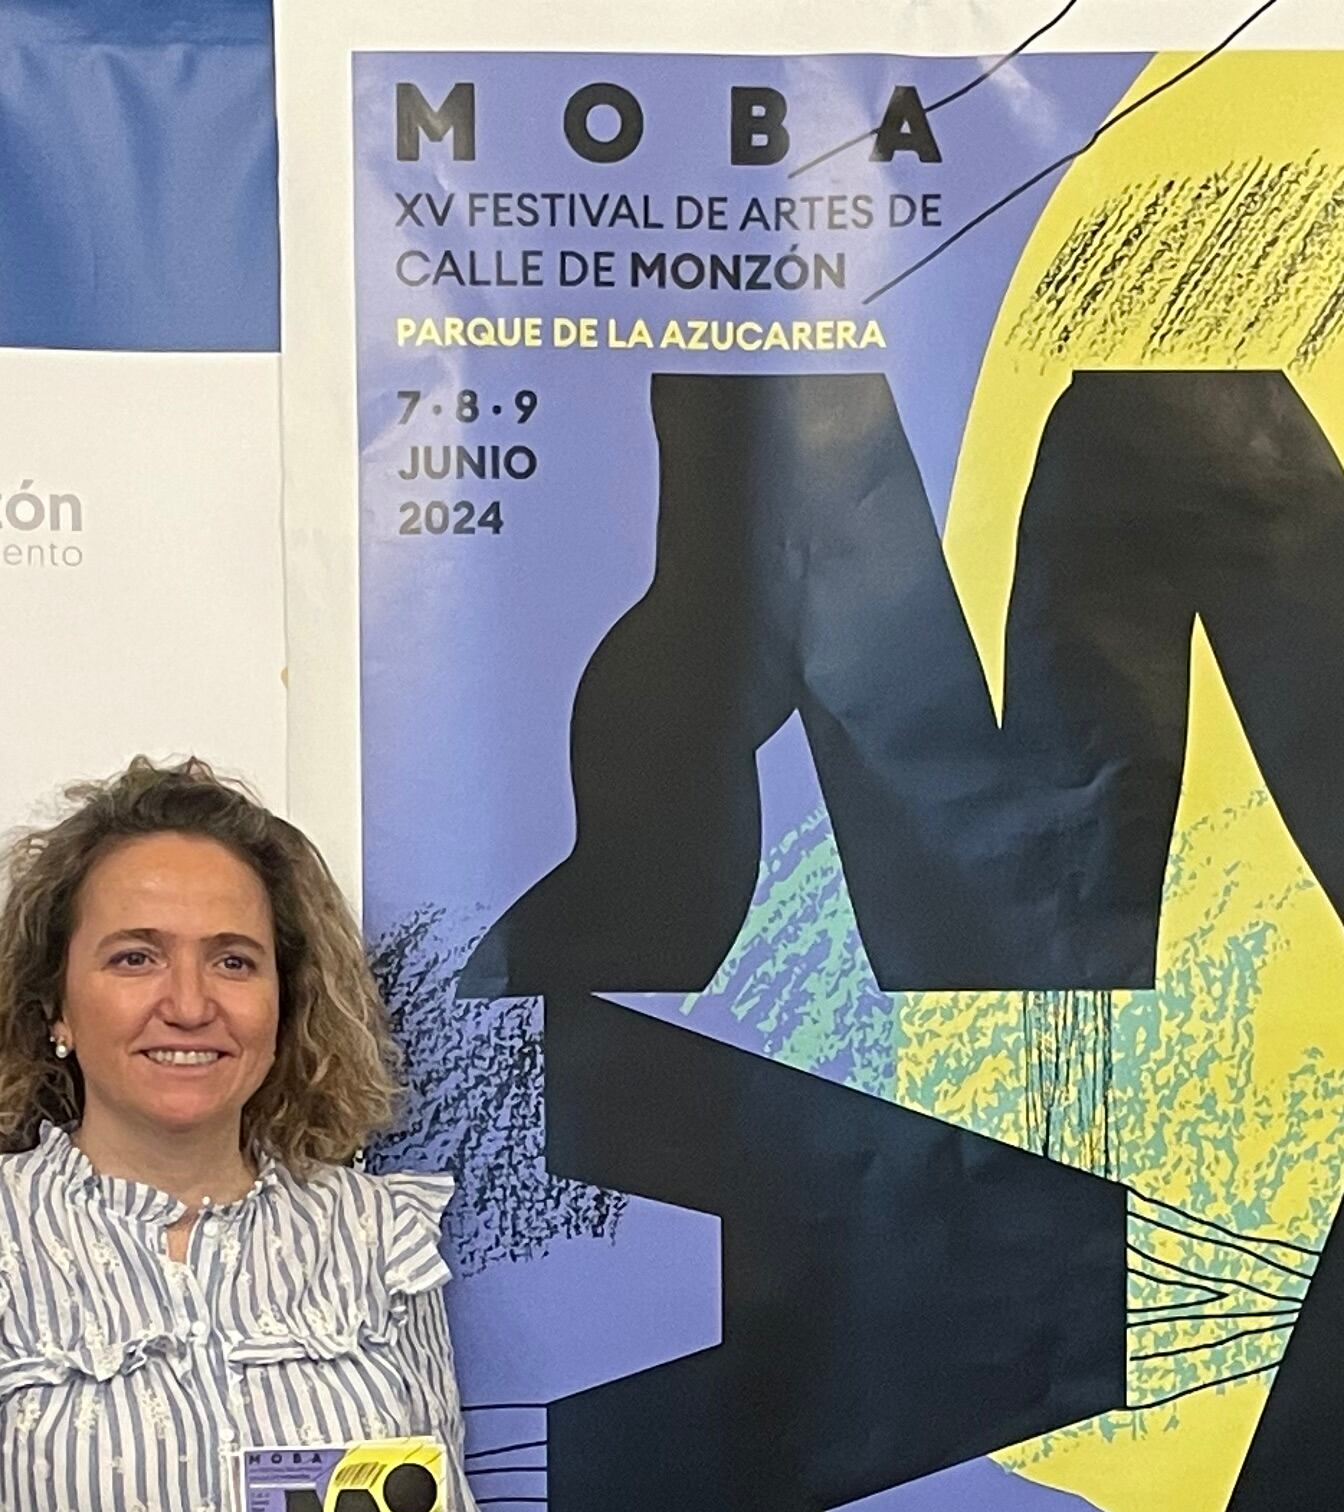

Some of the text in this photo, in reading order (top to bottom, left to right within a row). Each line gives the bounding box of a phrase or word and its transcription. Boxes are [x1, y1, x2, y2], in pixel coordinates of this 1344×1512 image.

[396, 82, 943, 166] MOBA
[396, 192, 943, 231] XV FESTIVAL DE ARTES DE
[396, 244, 845, 291] CALLE DE MONZÓN
[397, 318, 887, 351] PARQUE DE LA AZUCARERA
[398, 445, 538, 482] JUNIO
[398, 502, 504, 536] 2024
